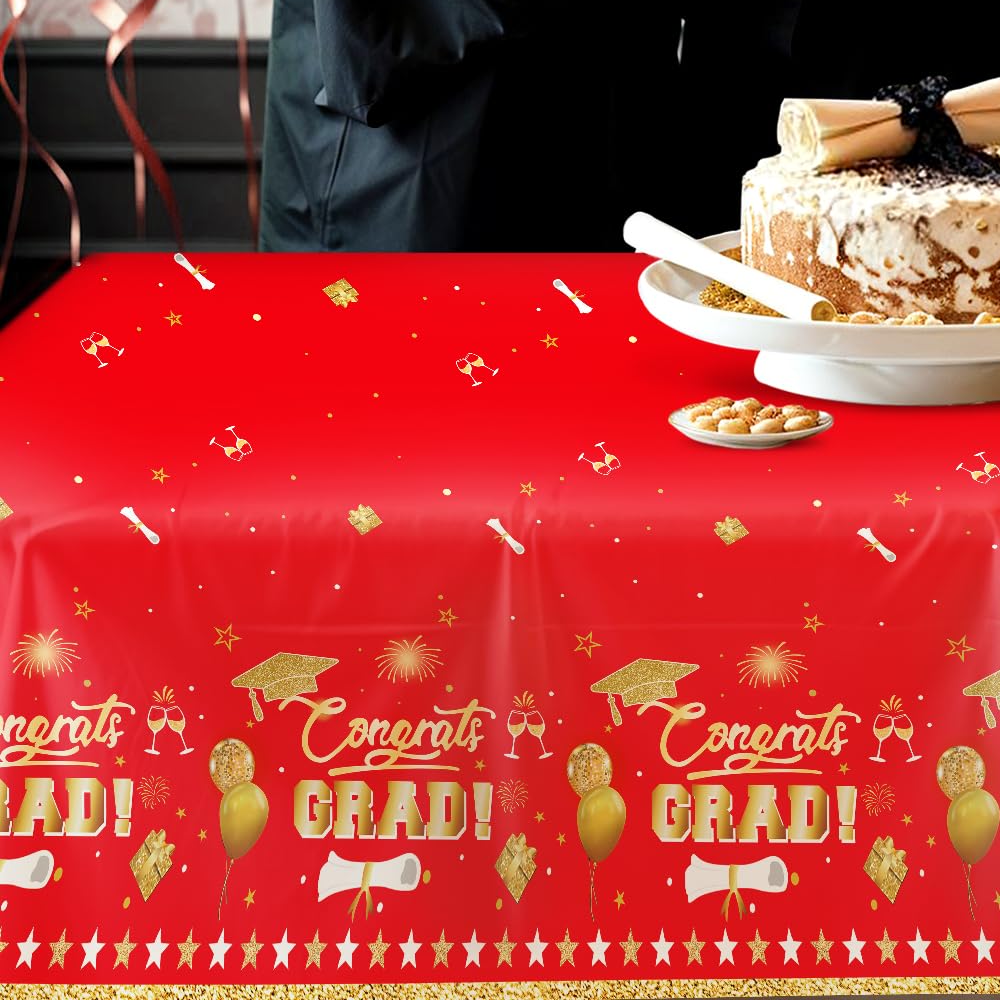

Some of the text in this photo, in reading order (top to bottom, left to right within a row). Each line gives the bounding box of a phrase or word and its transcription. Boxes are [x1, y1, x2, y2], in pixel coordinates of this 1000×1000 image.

[0, 693, 136, 768] ngrats
[278, 693, 497, 776] Congrats
[636, 700, 862, 780] Congrats
[0, 777, 134, 838] AD!
[293, 779, 494, 841] GRAD!
[651, 783, 858, 844] GRAD!
